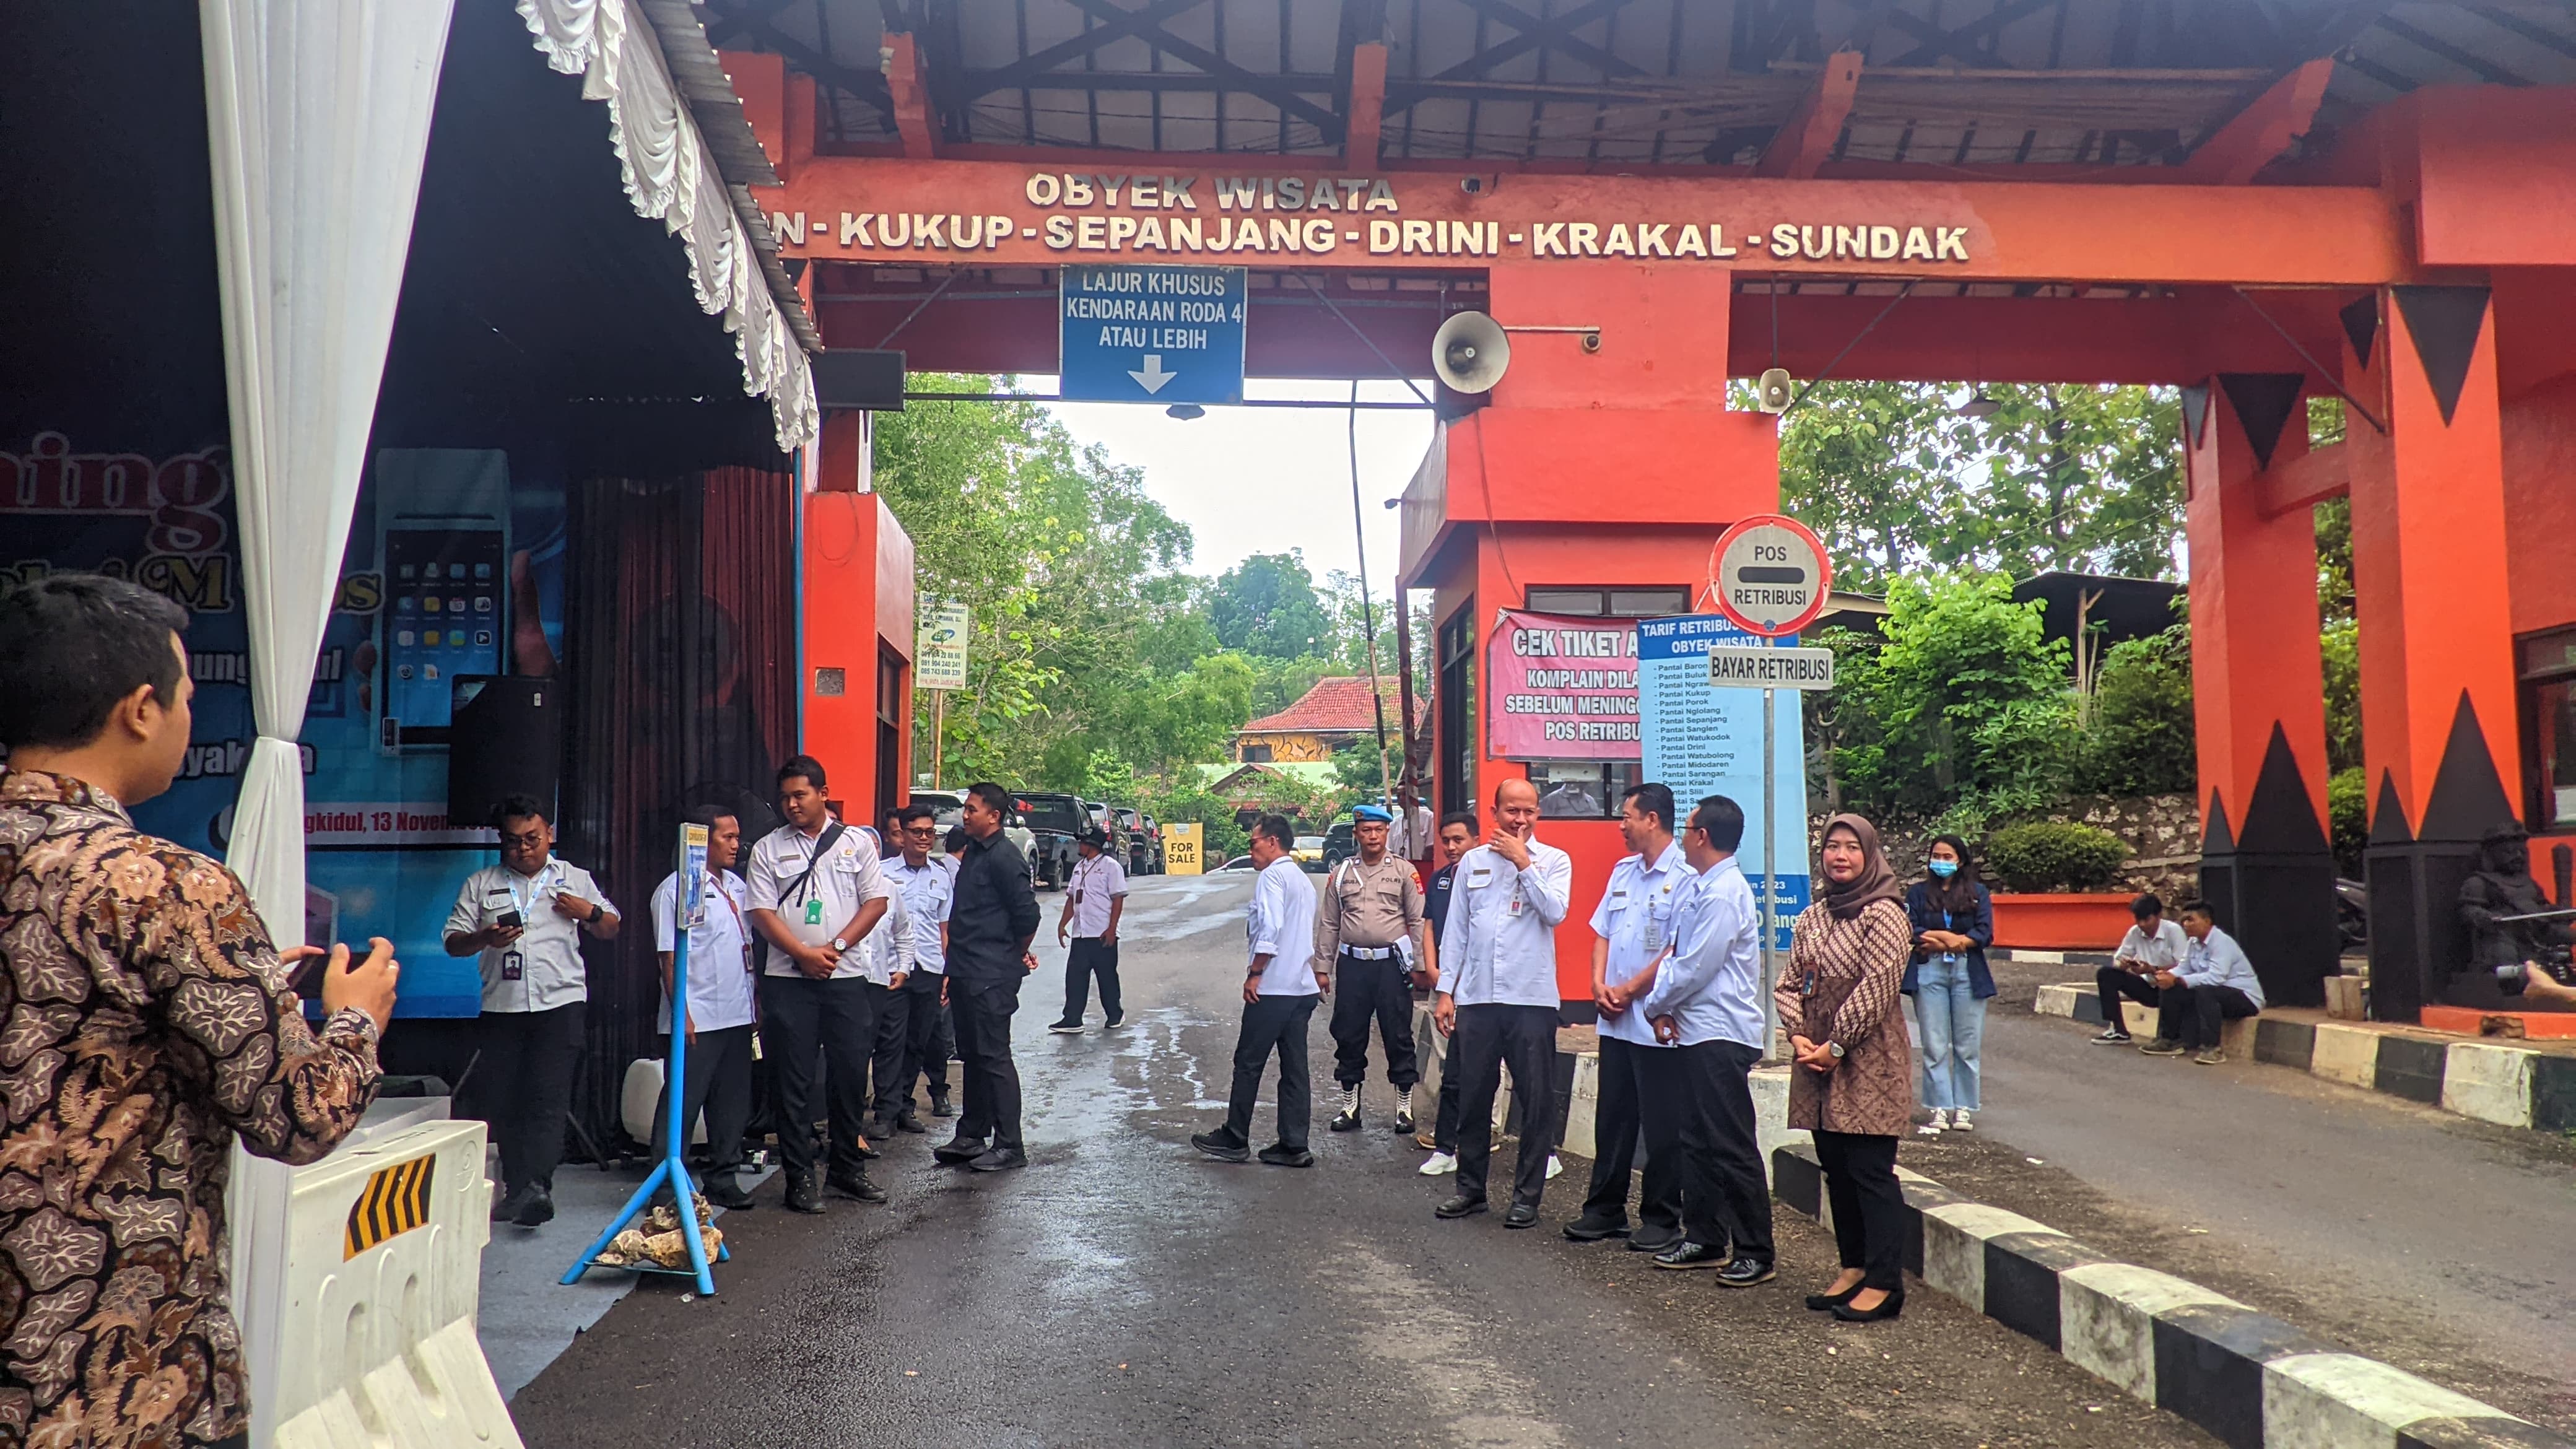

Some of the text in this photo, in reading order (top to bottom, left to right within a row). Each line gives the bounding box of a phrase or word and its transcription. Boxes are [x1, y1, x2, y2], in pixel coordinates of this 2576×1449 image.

[1026, 173, 1398, 211] OBYEK WISATA
[772, 212, 804, 245] N
[840, 212, 1013, 248] KUKUP
[1045, 216, 1336, 252] SEPANJANG
[1369, 220, 1499, 255] DRINI
[1533, 223, 1736, 258] KRAKAL
[1770, 224, 1969, 260] SUNDAK
[1083, 272, 1225, 296] LAJUR KHUSUS
[1067, 297, 1242, 323] KENDARAAN RODA 4
[1099, 326, 1207, 349] ATAU LEBIH
[1754, 546, 1786, 561] POS
[1734, 589, 1806, 605] RETRIBUSI
[1642, 622, 1676, 637] TARIF
[1512, 629, 1557, 656] CEK
[1560, 630, 1621, 657] TIKET
[1671, 635, 1763, 653] OBYEK WISATA
[1712, 656, 1829, 681] BAYAR RETRIBUSI
[1527, 669, 1603, 689] KOMPLAIN
[1505, 695, 1573, 714] SEBELUM
[1545, 722, 1575, 741] POS
[371, 812, 392, 831] 13
[1171, 843, 1193, 852] FOR
[1168, 853, 1195, 863] SALE
[1760, 881, 1786, 889] 223
[1756, 895, 1798, 904] etbusi
